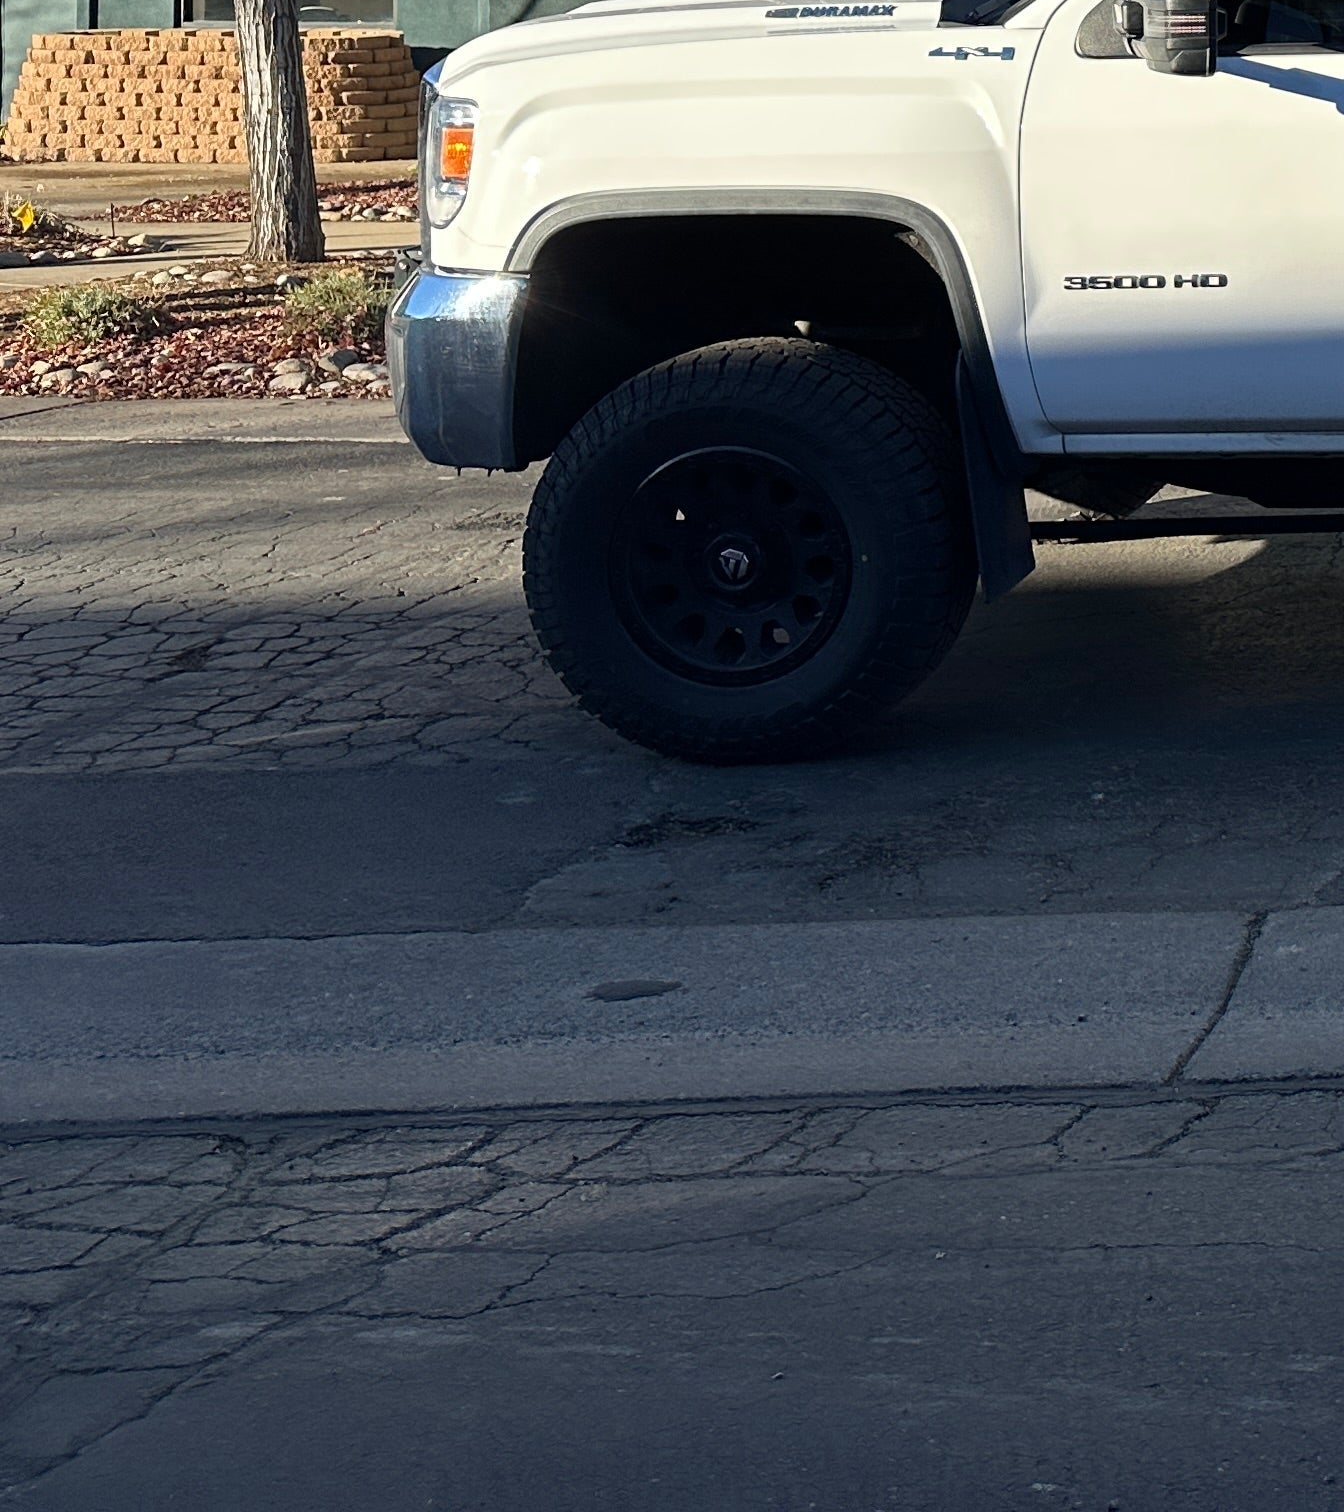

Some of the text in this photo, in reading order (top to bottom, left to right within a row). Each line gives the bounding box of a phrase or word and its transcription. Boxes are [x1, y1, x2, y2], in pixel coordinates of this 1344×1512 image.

[799, 4, 898, 18] DURAMAX
[1063, 274, 1228, 289] 3500 HD
